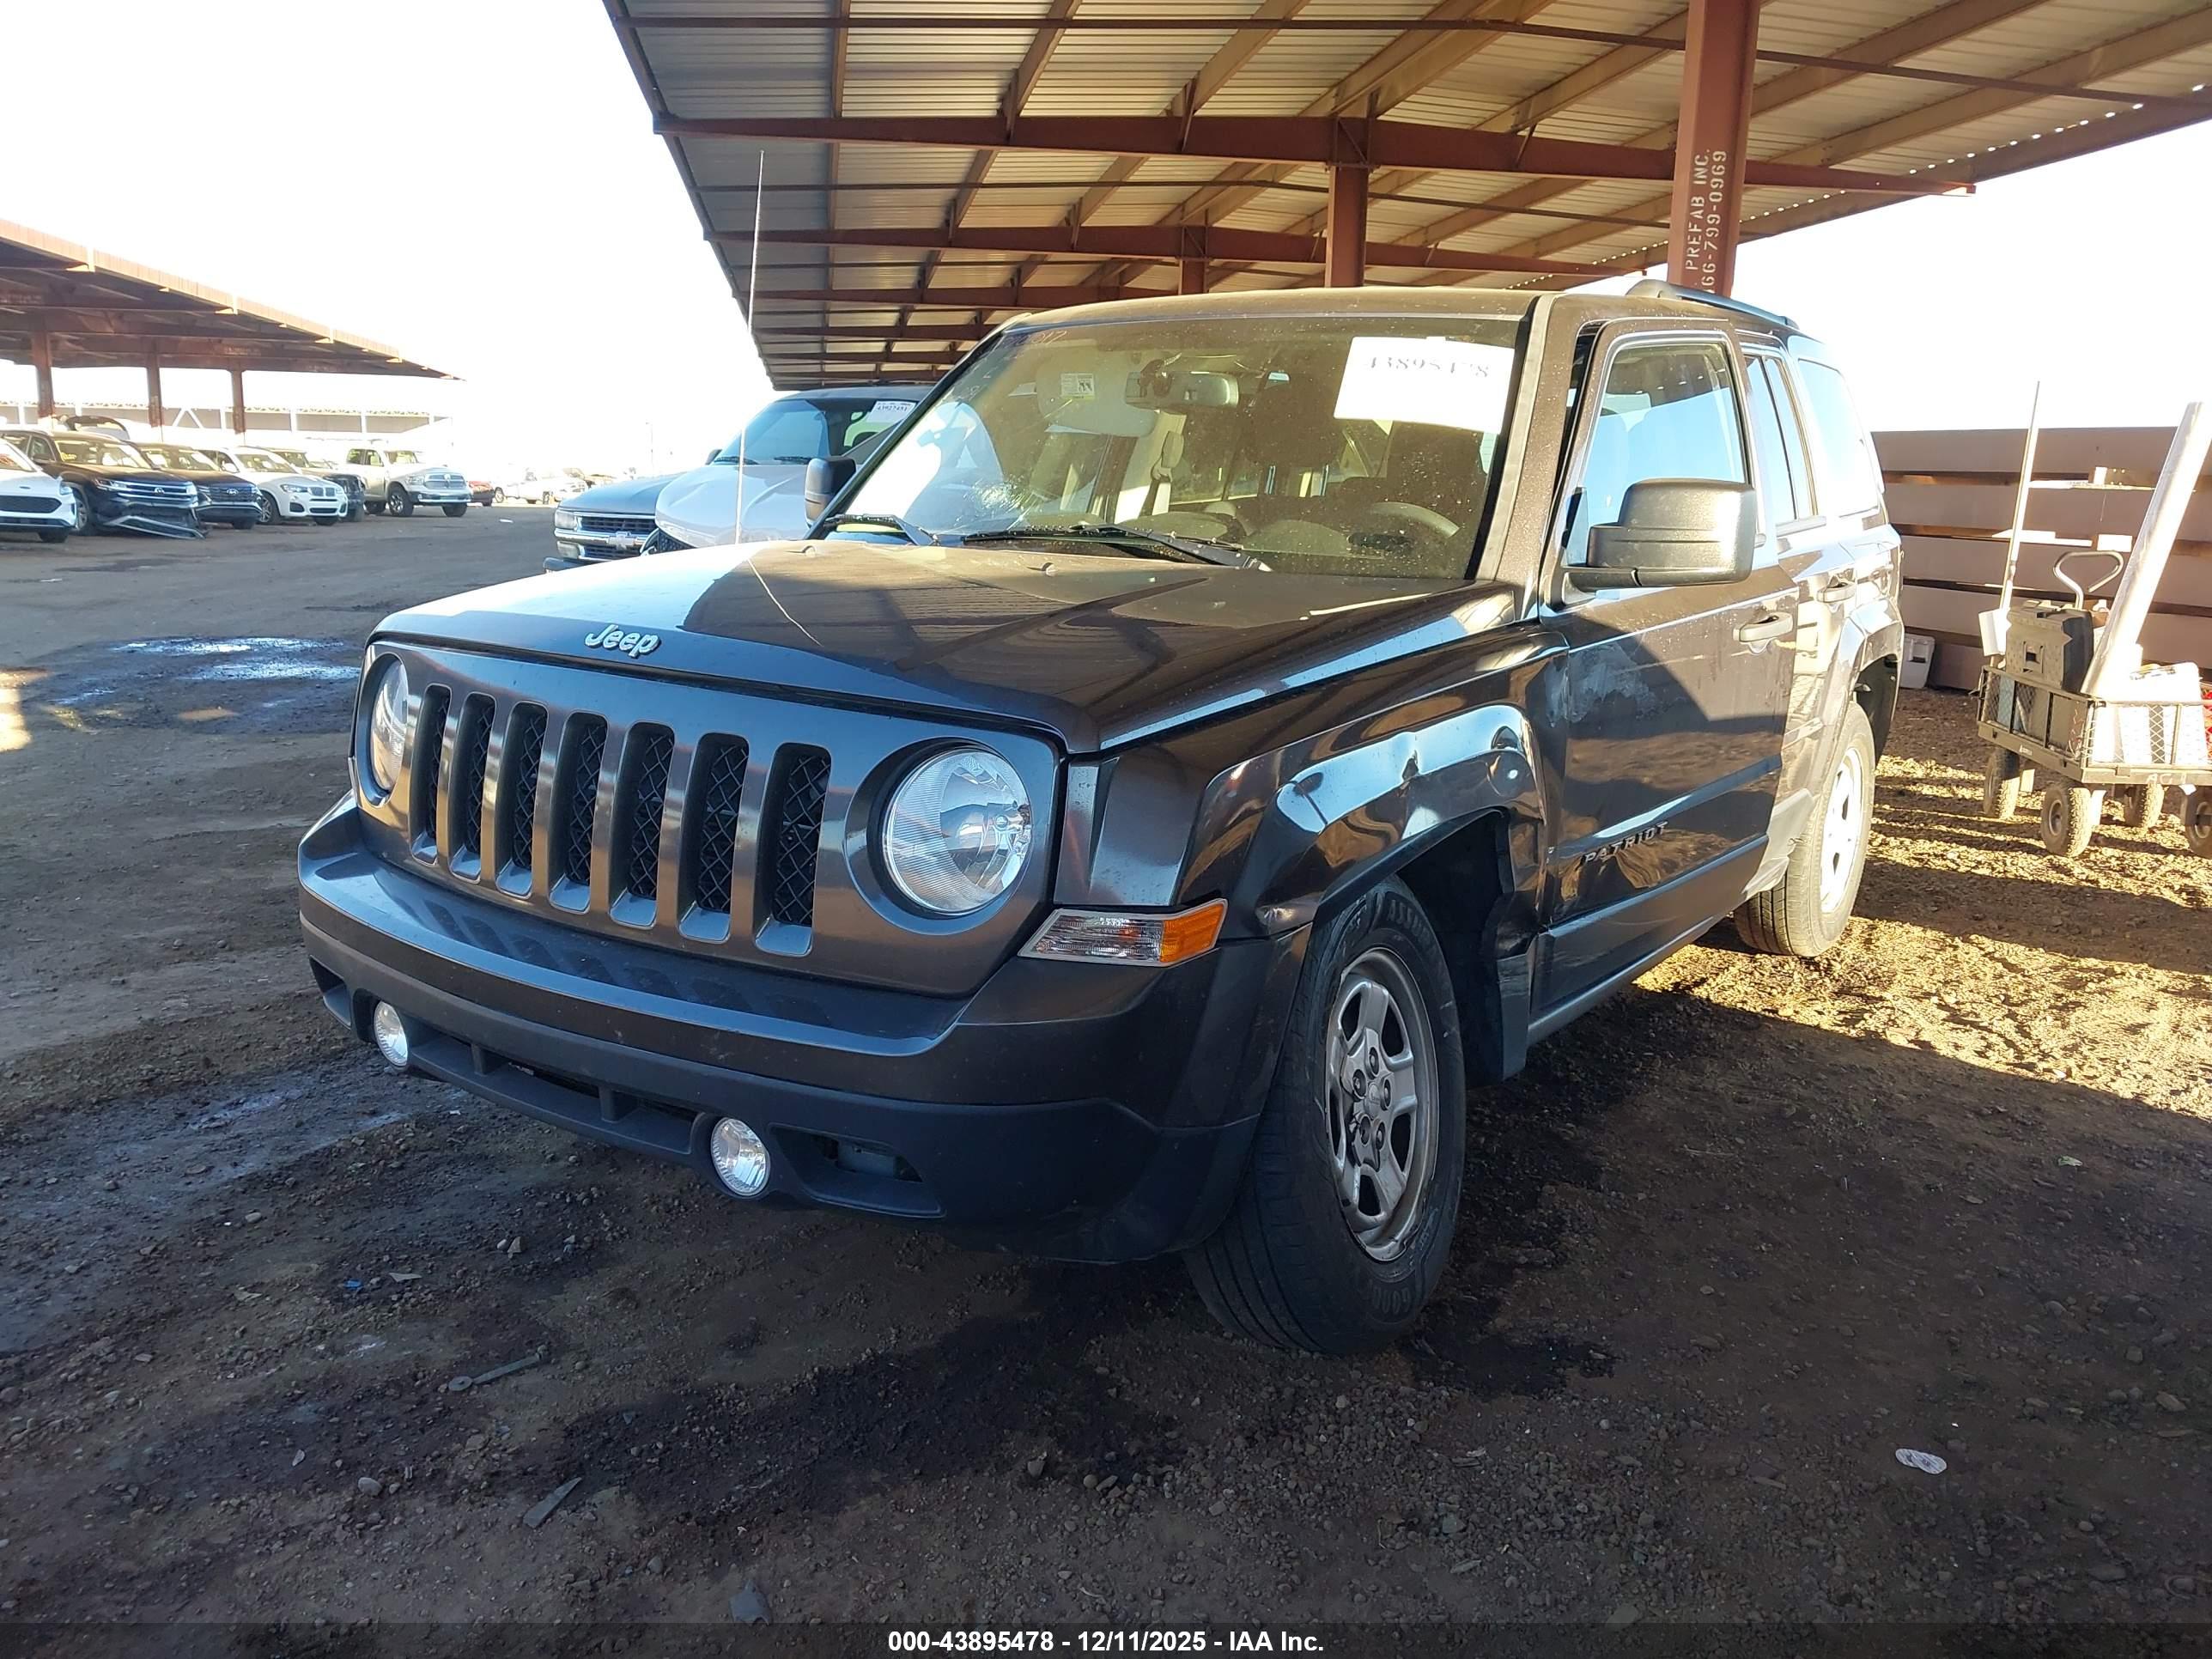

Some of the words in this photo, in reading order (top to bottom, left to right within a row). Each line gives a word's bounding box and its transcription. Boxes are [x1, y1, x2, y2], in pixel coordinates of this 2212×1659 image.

[1693, 149, 1711, 185] INC.
[1685, 196, 1705, 270] PREFAB
[585, 623, 660, 658] Jeep
[1582, 821, 1668, 863] PATRIOT
